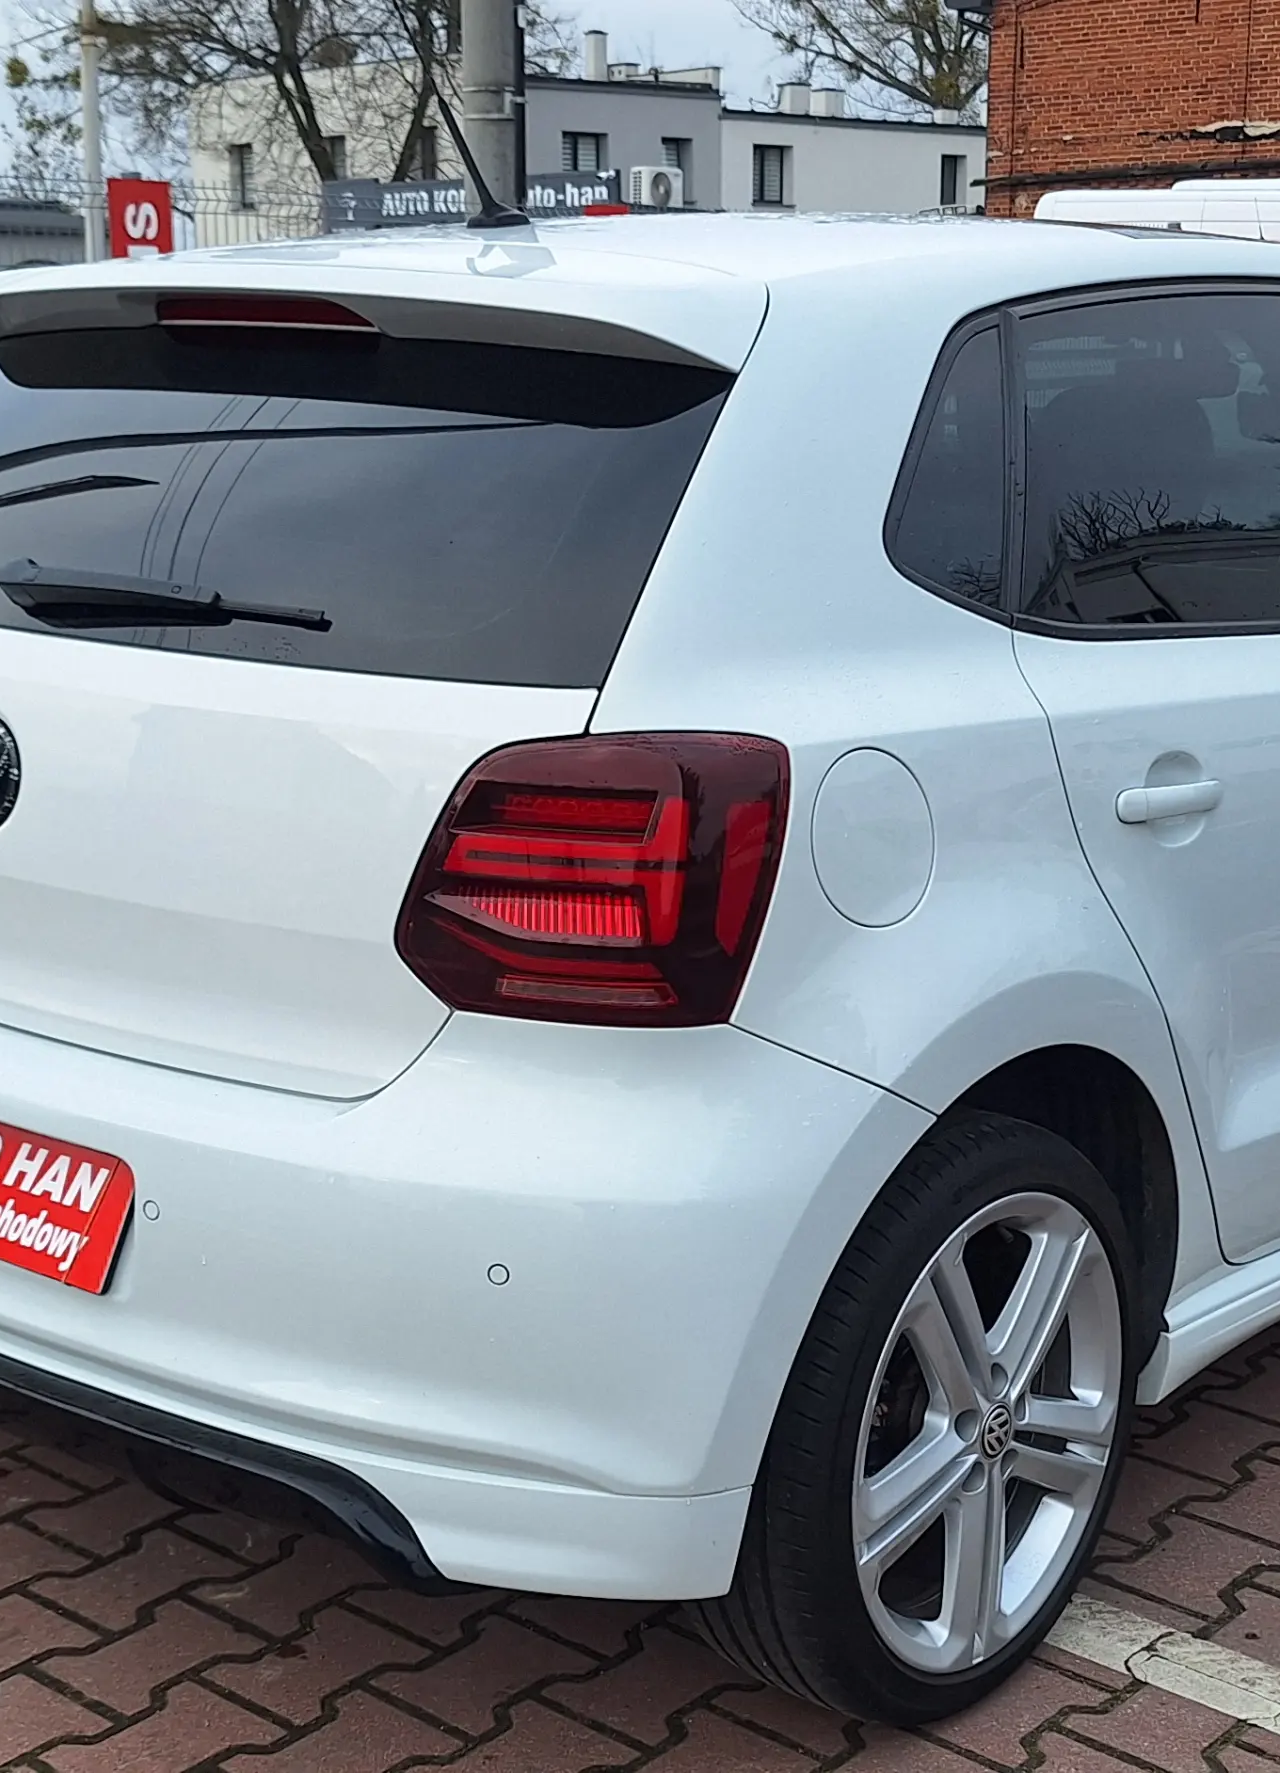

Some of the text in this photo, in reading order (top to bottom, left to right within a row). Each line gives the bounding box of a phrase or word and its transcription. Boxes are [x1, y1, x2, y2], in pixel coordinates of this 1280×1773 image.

[381, 190, 430, 217] AUTO
[525, 181, 609, 208] uto-han
[1, 1142, 110, 1214] HAN
